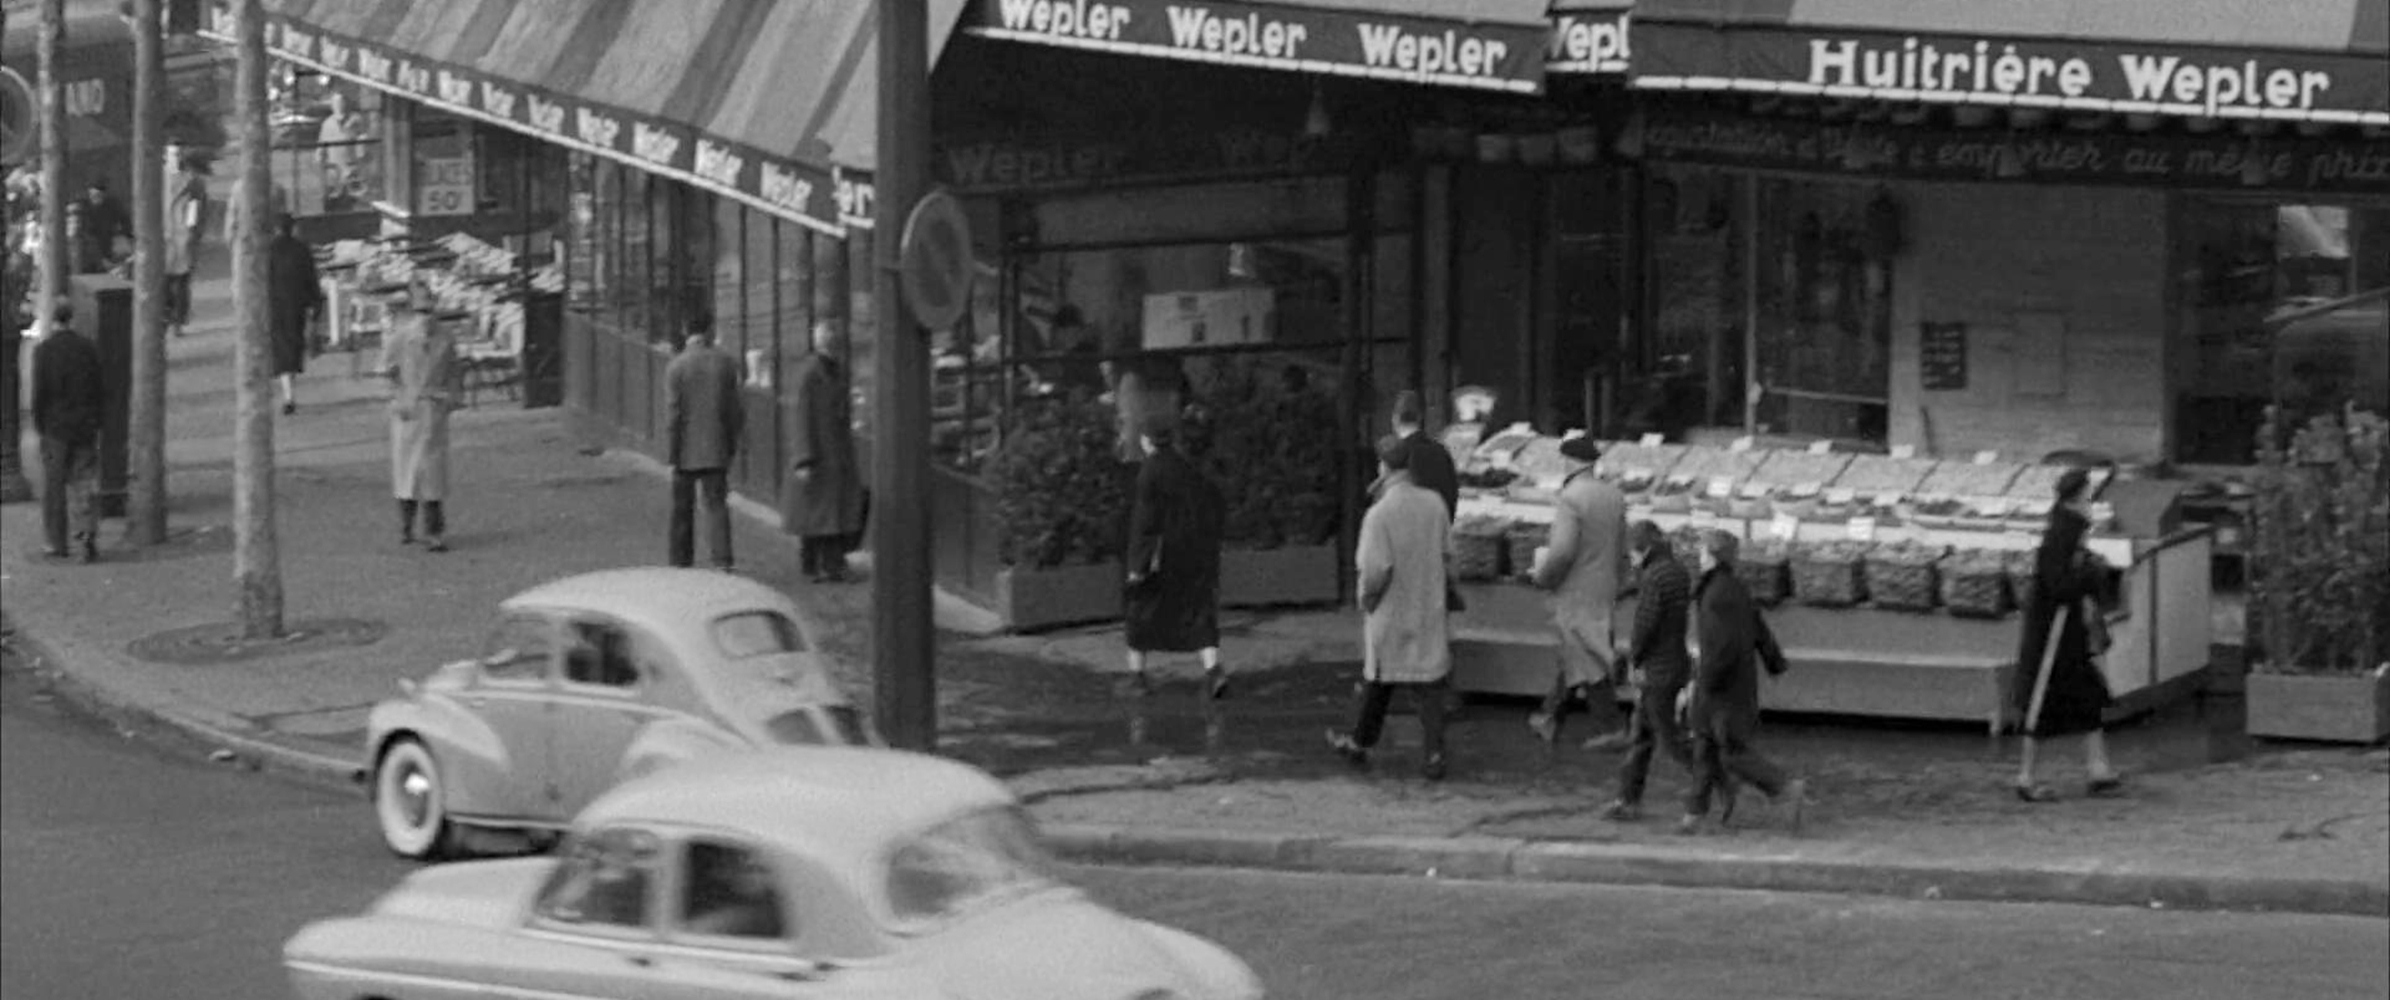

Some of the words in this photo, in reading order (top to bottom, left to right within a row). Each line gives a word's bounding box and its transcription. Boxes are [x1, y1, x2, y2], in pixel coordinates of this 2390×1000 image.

[1000, 0, 1131, 43] Wepler
[1166, 5, 1307, 62] Wepler
[1358, 23, 1507, 82] Wepler
[2120, 54, 2330, 116] Wepler
[2182, 145, 2290, 177] mêe
